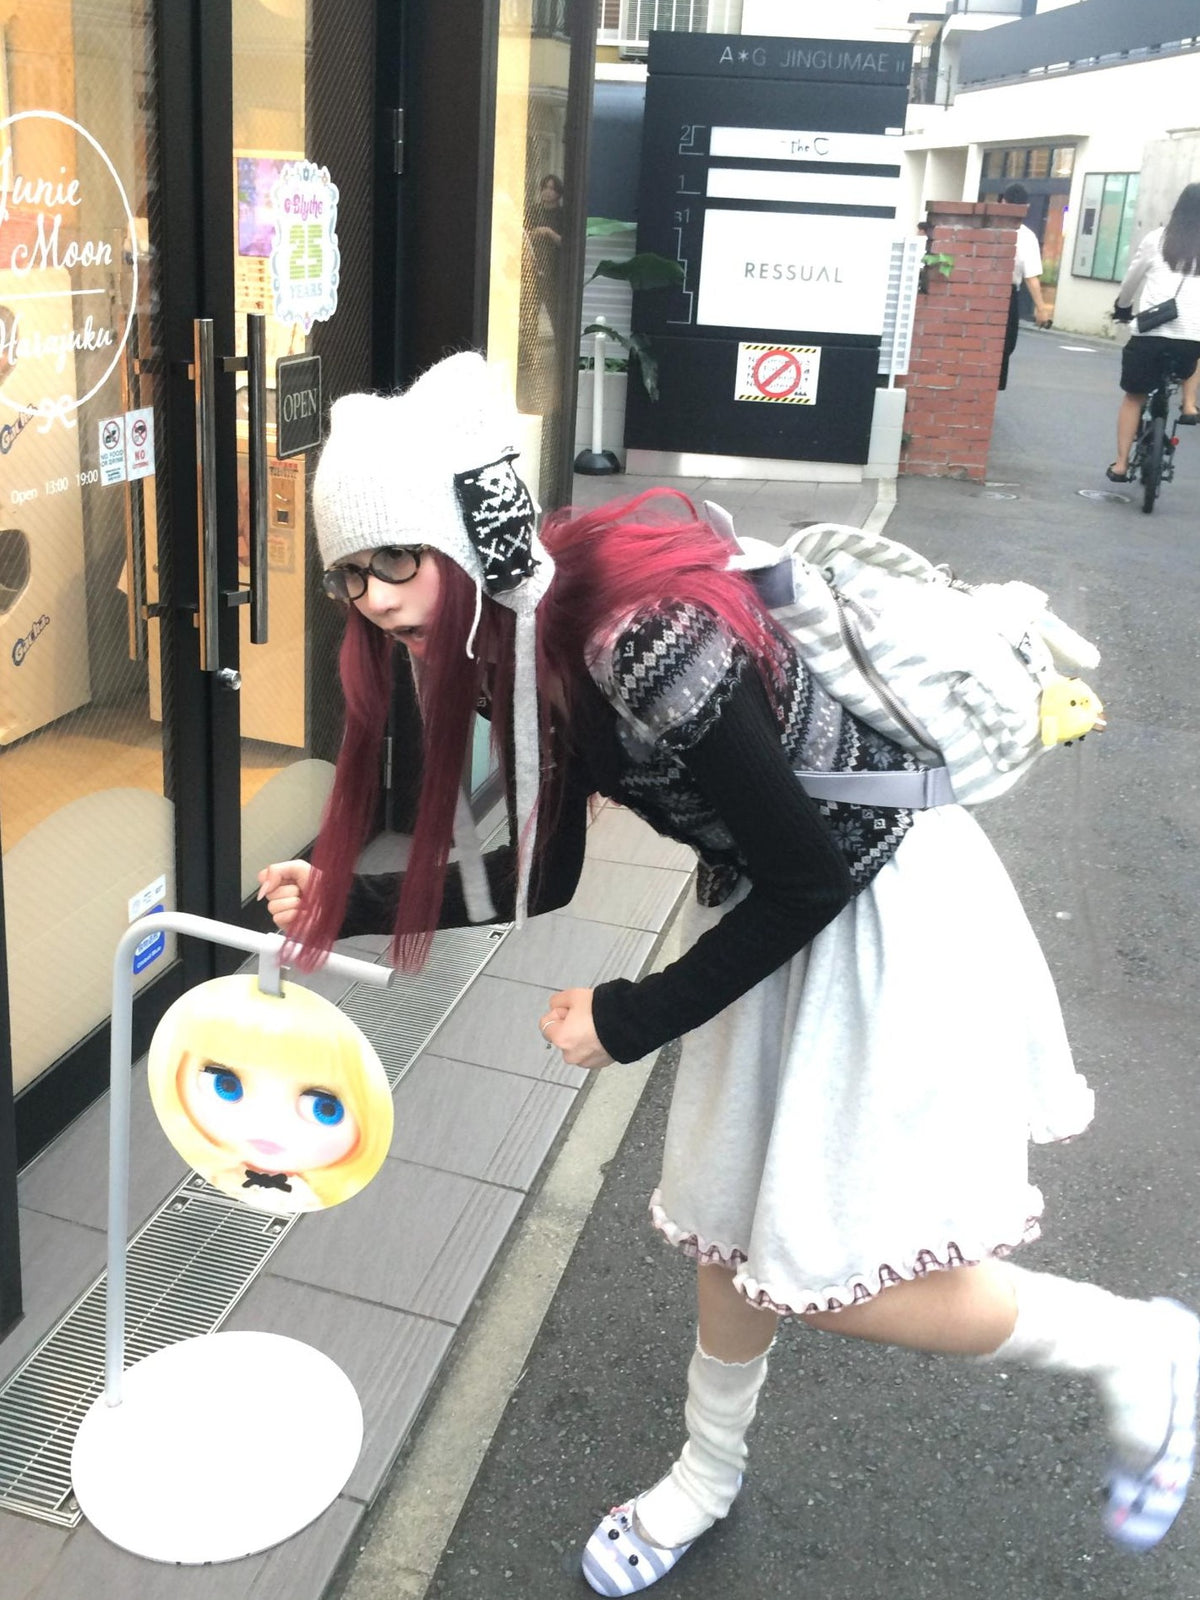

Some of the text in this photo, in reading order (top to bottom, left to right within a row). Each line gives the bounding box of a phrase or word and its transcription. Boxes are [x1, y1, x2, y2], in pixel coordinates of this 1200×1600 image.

[780, 50, 889, 72] JINGUMAE
[680, 125, 691, 141] 2
[11, 213, 112, 277] Moon
[289, 225, 323, 279] 25
[744, 262, 843, 284] RESSUAL
[290, 282, 323, 299] YEARS
[283, 388, 318, 422] OPEN
[134, 449, 146, 462] NO
[10, 488, 38, 506] Open
[45, 476, 69, 495] 13:00
[76, 469, 98, 488] 19:00
